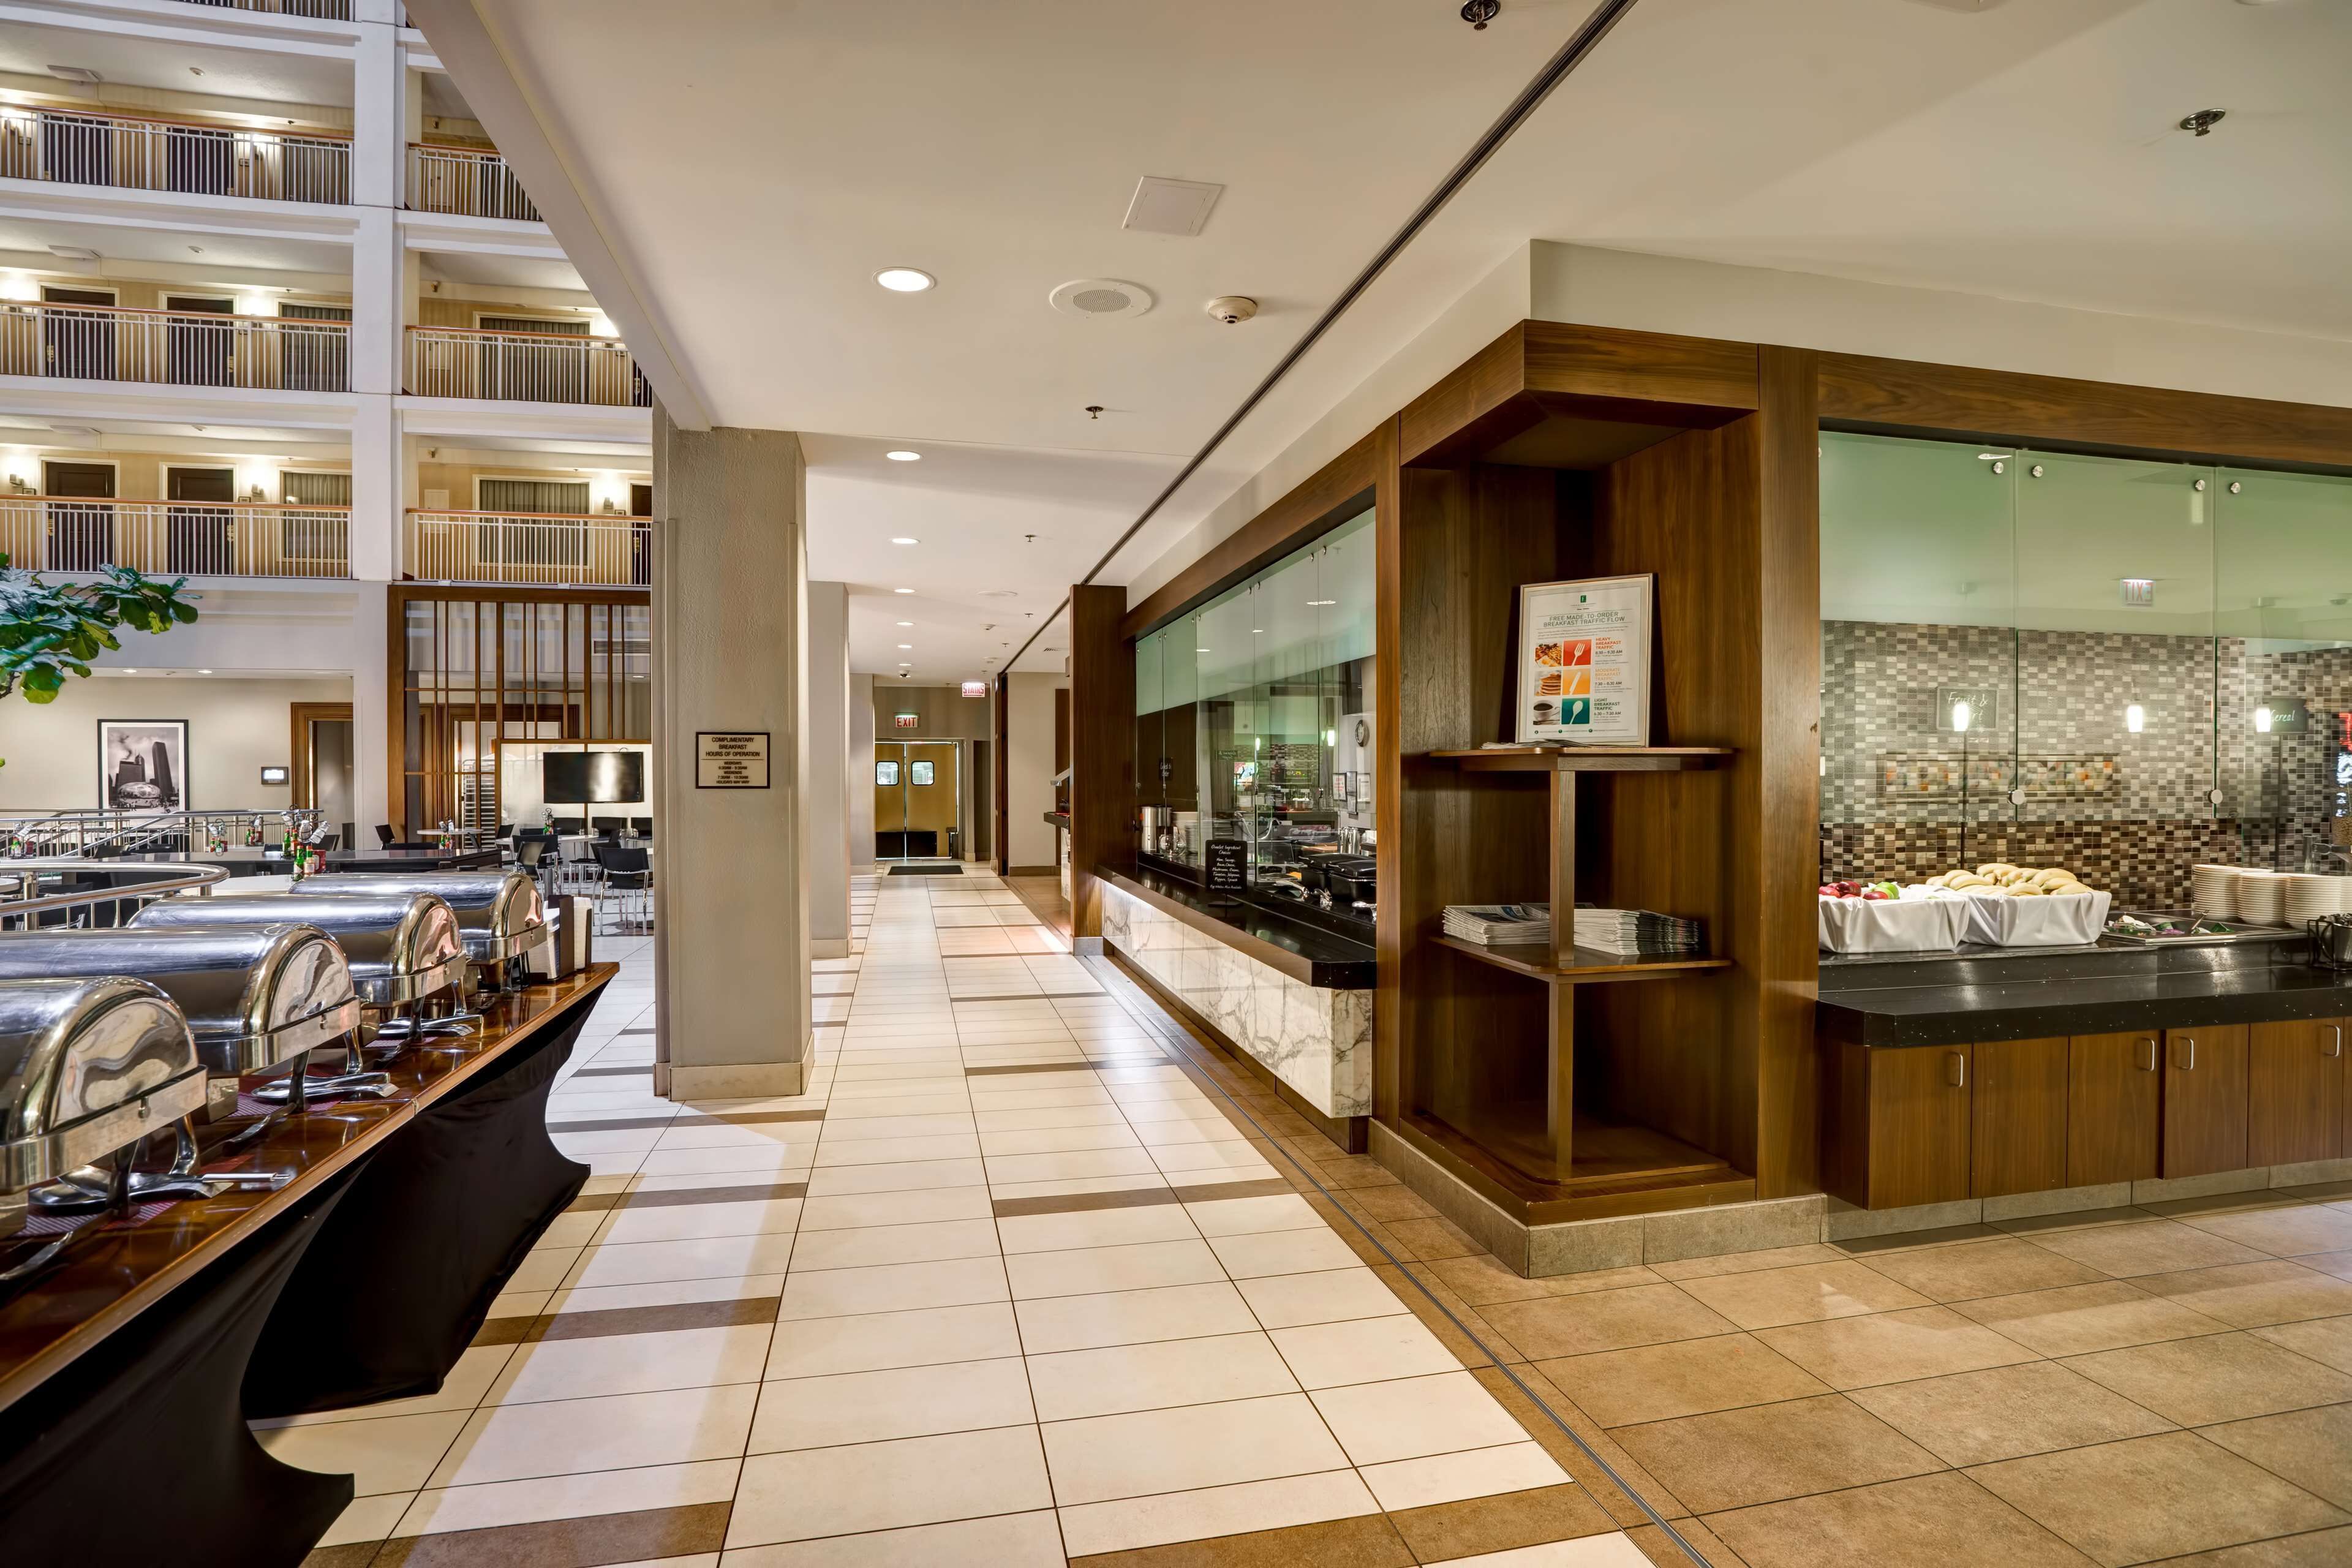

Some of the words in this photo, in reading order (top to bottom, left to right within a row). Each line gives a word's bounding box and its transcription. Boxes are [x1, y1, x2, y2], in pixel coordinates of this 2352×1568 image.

[1566, 611, 1619, 620] MADE-TO-ORDER
[963, 684, 984, 694] STAIRS
[1948, 691, 1976, 705] Fruit
[1979, 693, 1988, 707] &
[897, 717, 916, 727] EXIT
